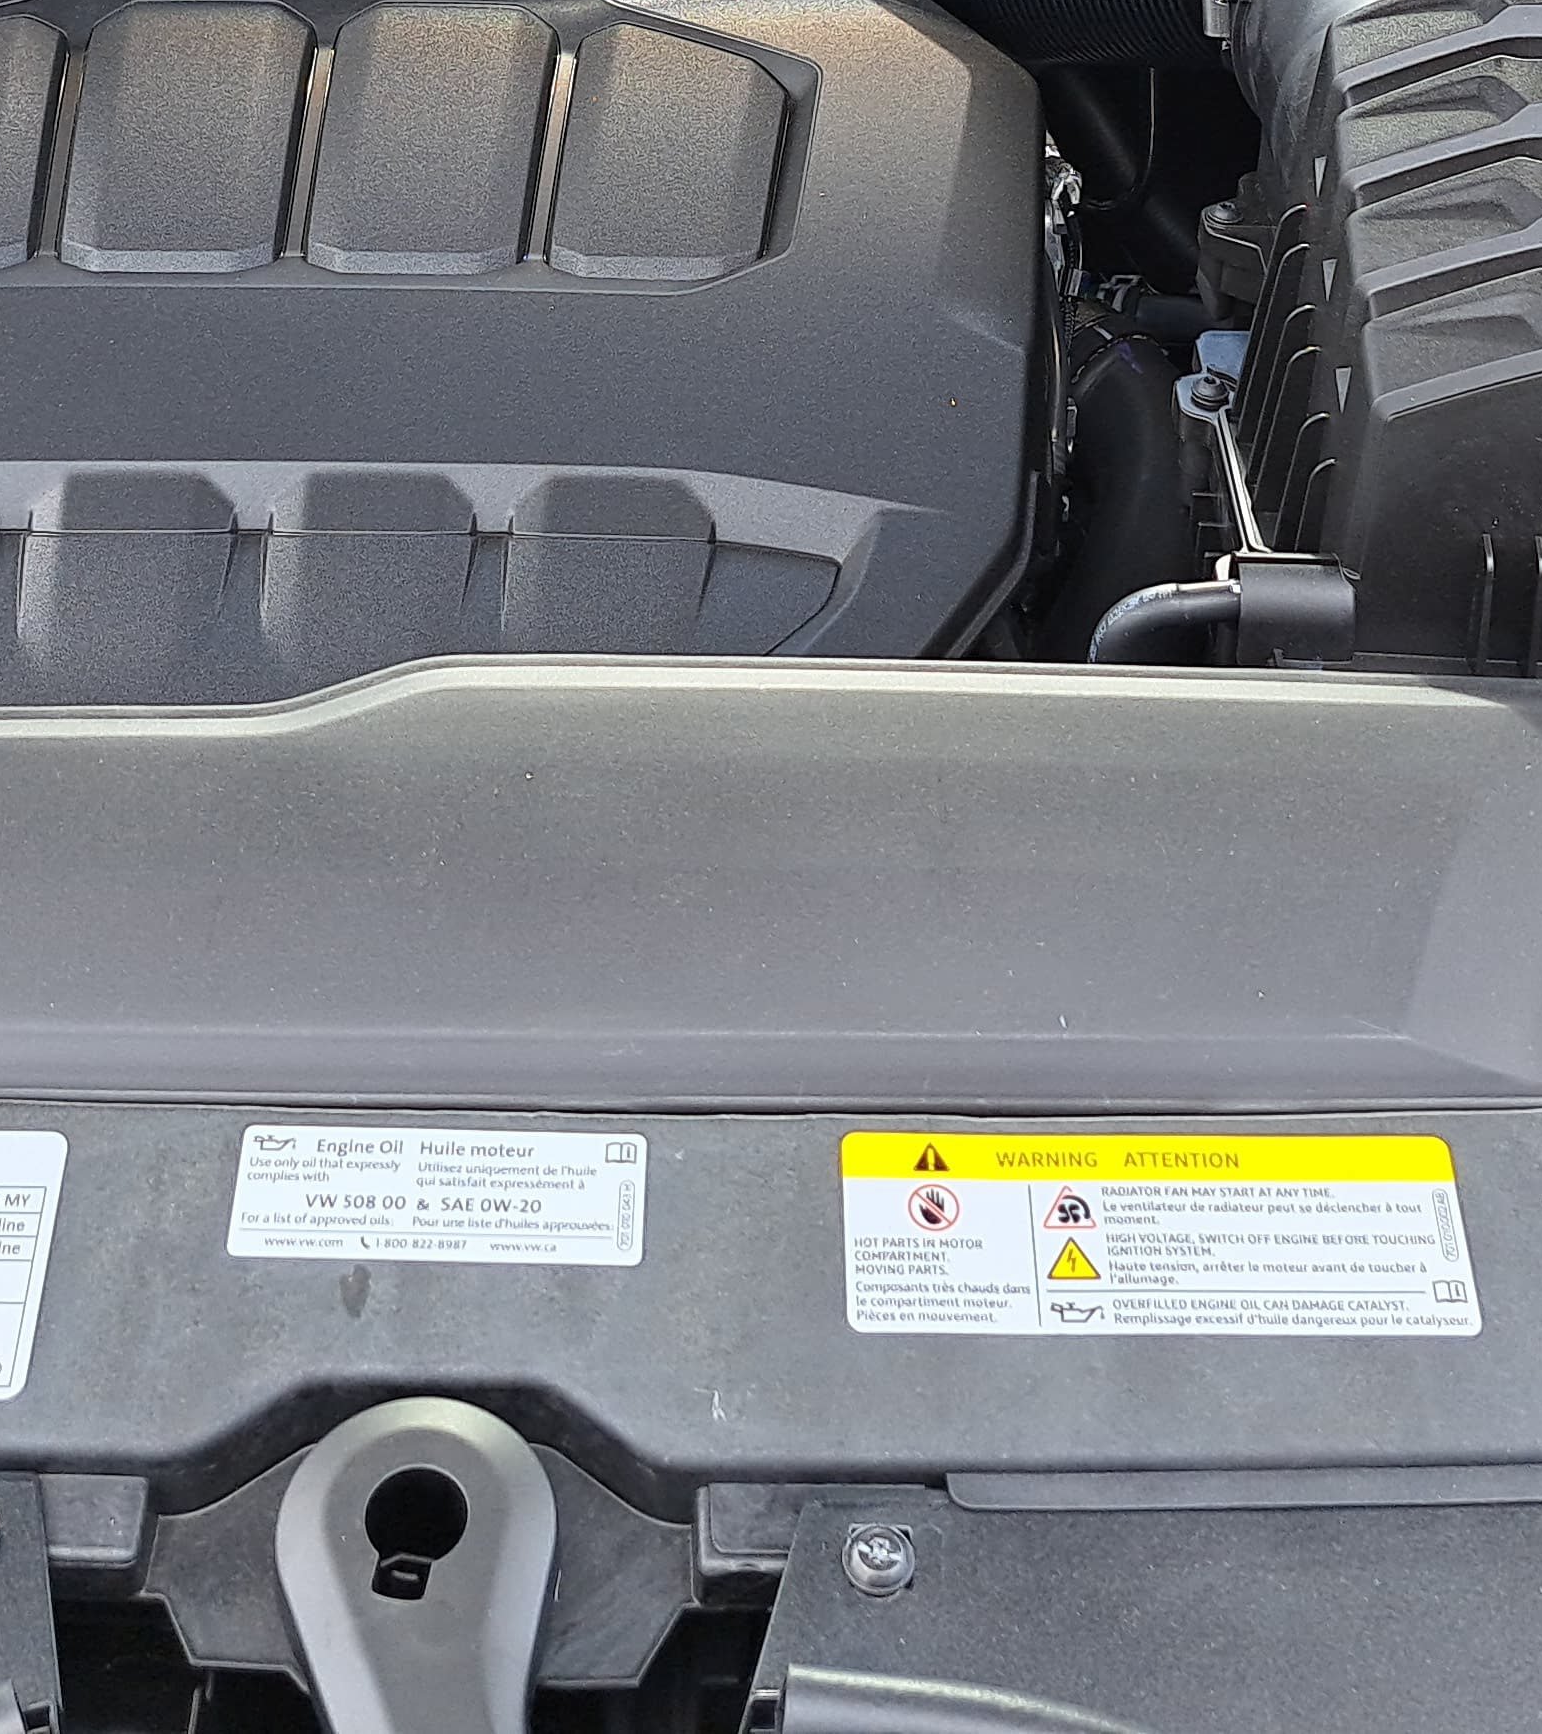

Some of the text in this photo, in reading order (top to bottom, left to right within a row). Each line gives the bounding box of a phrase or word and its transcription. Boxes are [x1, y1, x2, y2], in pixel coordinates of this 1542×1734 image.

[317, 1139, 403, 1156] Engine Oil
[420, 1141, 535, 1157] Huile moteur
[250, 1157, 401, 1171] Use only oil that expressly
[996, 1151, 1240, 1169] WARNING ATTENTION
[418, 1163, 597, 1176] Utilisez uniquement de l'huile
[247, 1171, 329, 1183] complies with
[416, 1177, 585, 1190] qui satisfait expressément à
[1101, 1187, 1160, 1197] RADIATOR
[1165, 1188, 1188, 1197] FAN
[1192, 1188, 1215, 1197] MAY
[1219, 1188, 1254, 1197] START
[1259, 1188, 1273, 1197] AT
[1277, 1188, 1299, 1198] ANY
[4, 1194, 31, 1207] MY
[306, 1194, 542, 1213] VW 508 00 & SAE 0W-20
[1103, 1201, 1421, 1215] Le ventilateur de radiateur peut se déclencher à tout
[242, 1212, 260, 1223] For
[273, 1213, 291, 1224] list
[295, 1213, 307, 1224] of
[310, 1214, 366, 1226] approved
[412, 1217, 439, 1227] Pour
[468, 1220, 491, 1228] liste
[495, 1220, 539, 1229] d'huiles
[1104, 1216, 1159, 1224] moment.
[265, 1238, 343, 1247] www.vw.com
[490, 1242, 556, 1252] www.vw.ca
[855, 1238, 983, 1249] HOT PARTS IN MOTOR
[1106, 1234, 1136, 1243] HIGH
[1198, 1234, 1244, 1244] SWITCH
[1248, 1234, 1271, 1244] OFF
[1274, 1235, 1319, 1244] ENGINE
[1322, 1235, 1369, 1245] BEFORE
[1373, 1235, 1435, 1245] TOUCHING
[855, 1251, 950, 1262] COMPARTMENT.
[1107, 1246, 1161, 1256] IGNITION
[856, 1265, 948, 1275] MOVING PARTS.
[1109, 1261, 1146, 1271] Haute
[1203, 1262, 1244, 1272] arrêter
[1248, 1262, 1259, 1272] le
[1263, 1264, 1309, 1272] moteur
[1312, 1263, 1347, 1272] avant
[1350, 1263, 1365, 1272] de
[1369, 1263, 1416, 1272] toucher
[1420, 1263, 1427, 1273] à
[856, 1282, 1031, 1294] Composants très chauds dans
[856, 1296, 867, 1305] le
[871, 1296, 959, 1308] compartiment
[1113, 1299, 1409, 1311] OVERFILLED ENGINE OIL CAN DAMAGE CATALYST.
[857, 1310, 895, 1321] Pièces
[900, 1313, 914, 1321] en
[1114, 1313, 1191, 1326] Remplissage
[1195, 1314, 1243, 1324] excessif
[1247, 1314, 1288, 1325] d'huile
[1292, 1315, 1356, 1327] dangereux
[1361, 1317, 1388, 1327] pour
[1392, 1315, 1402, 1325] le
